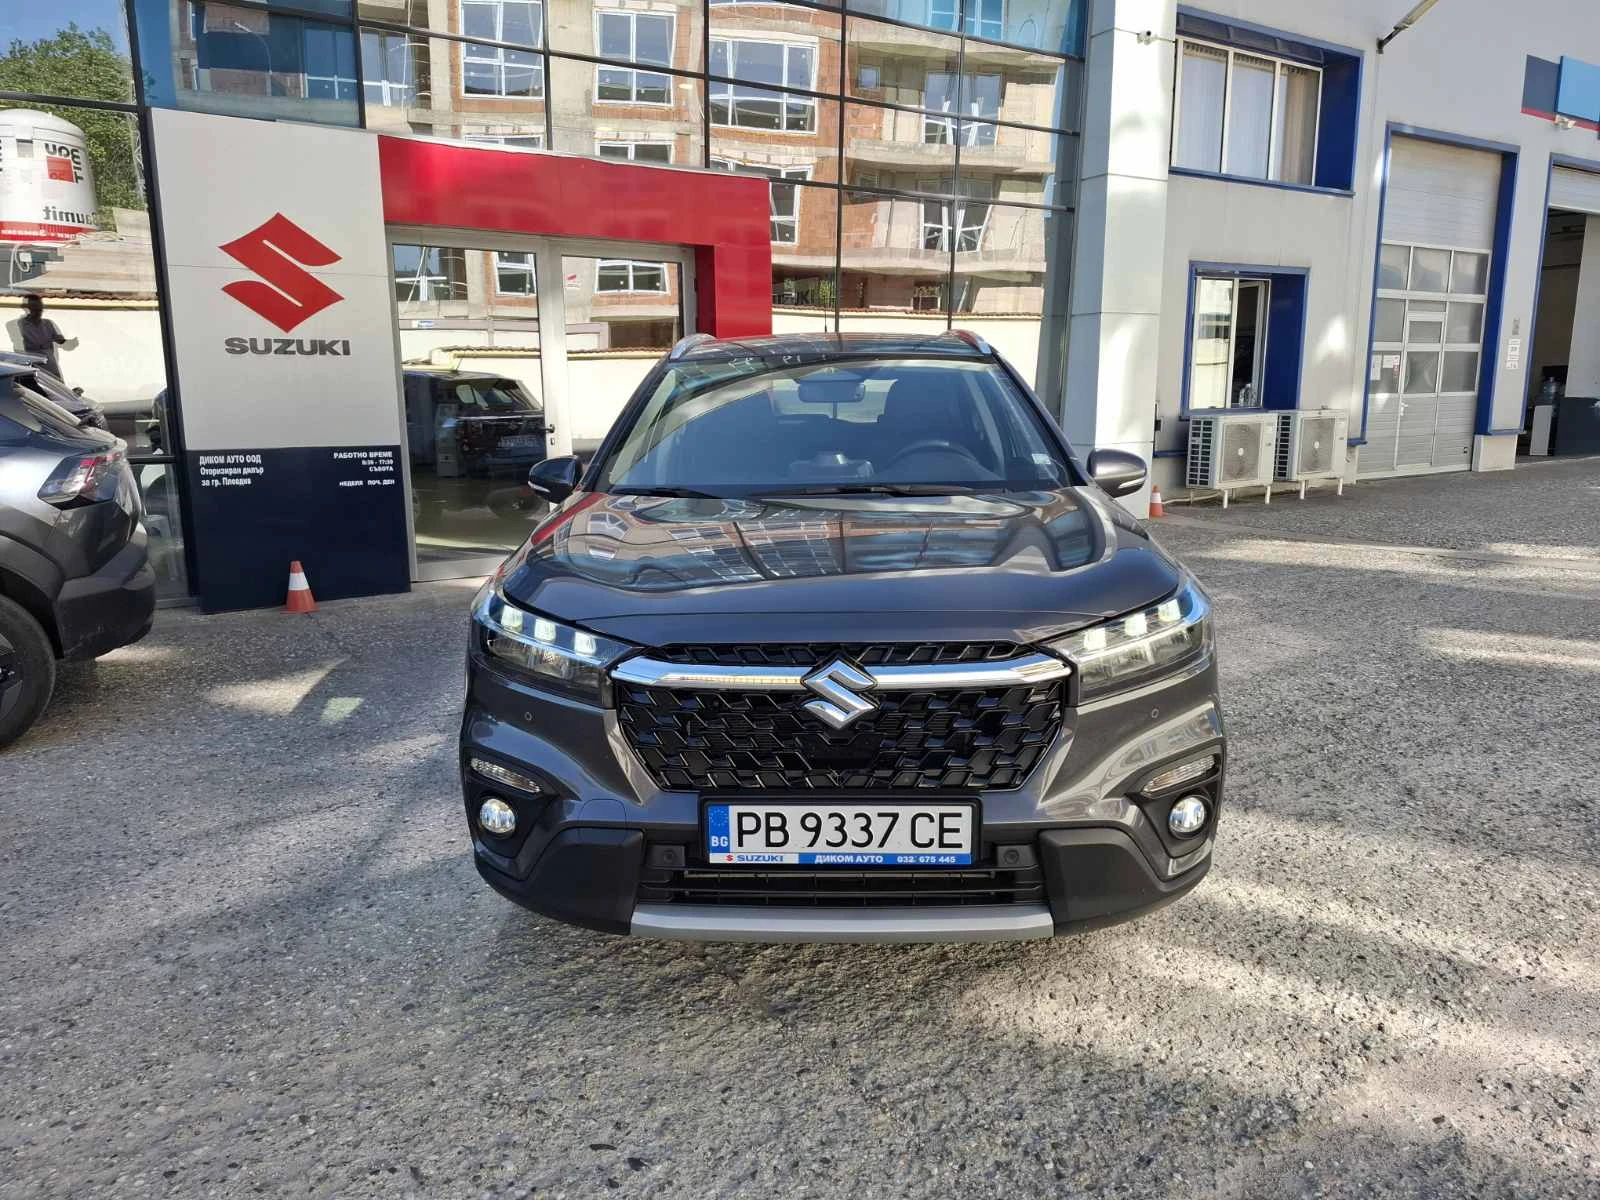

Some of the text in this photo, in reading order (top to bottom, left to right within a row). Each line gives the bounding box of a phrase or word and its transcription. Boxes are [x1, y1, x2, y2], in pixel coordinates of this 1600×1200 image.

[224, 337, 350, 356] SUZUKI
[200, 455, 225, 465] ДИКОМ
[226, 455, 244, 463] АУТО
[737, 812, 962, 848] PB 9337 CE
[711, 836, 728, 847] BG
[815, 855, 883, 864] ДИКОМ АУТО
[919, 855, 936, 863] 675
[938, 855, 956, 863] 445
